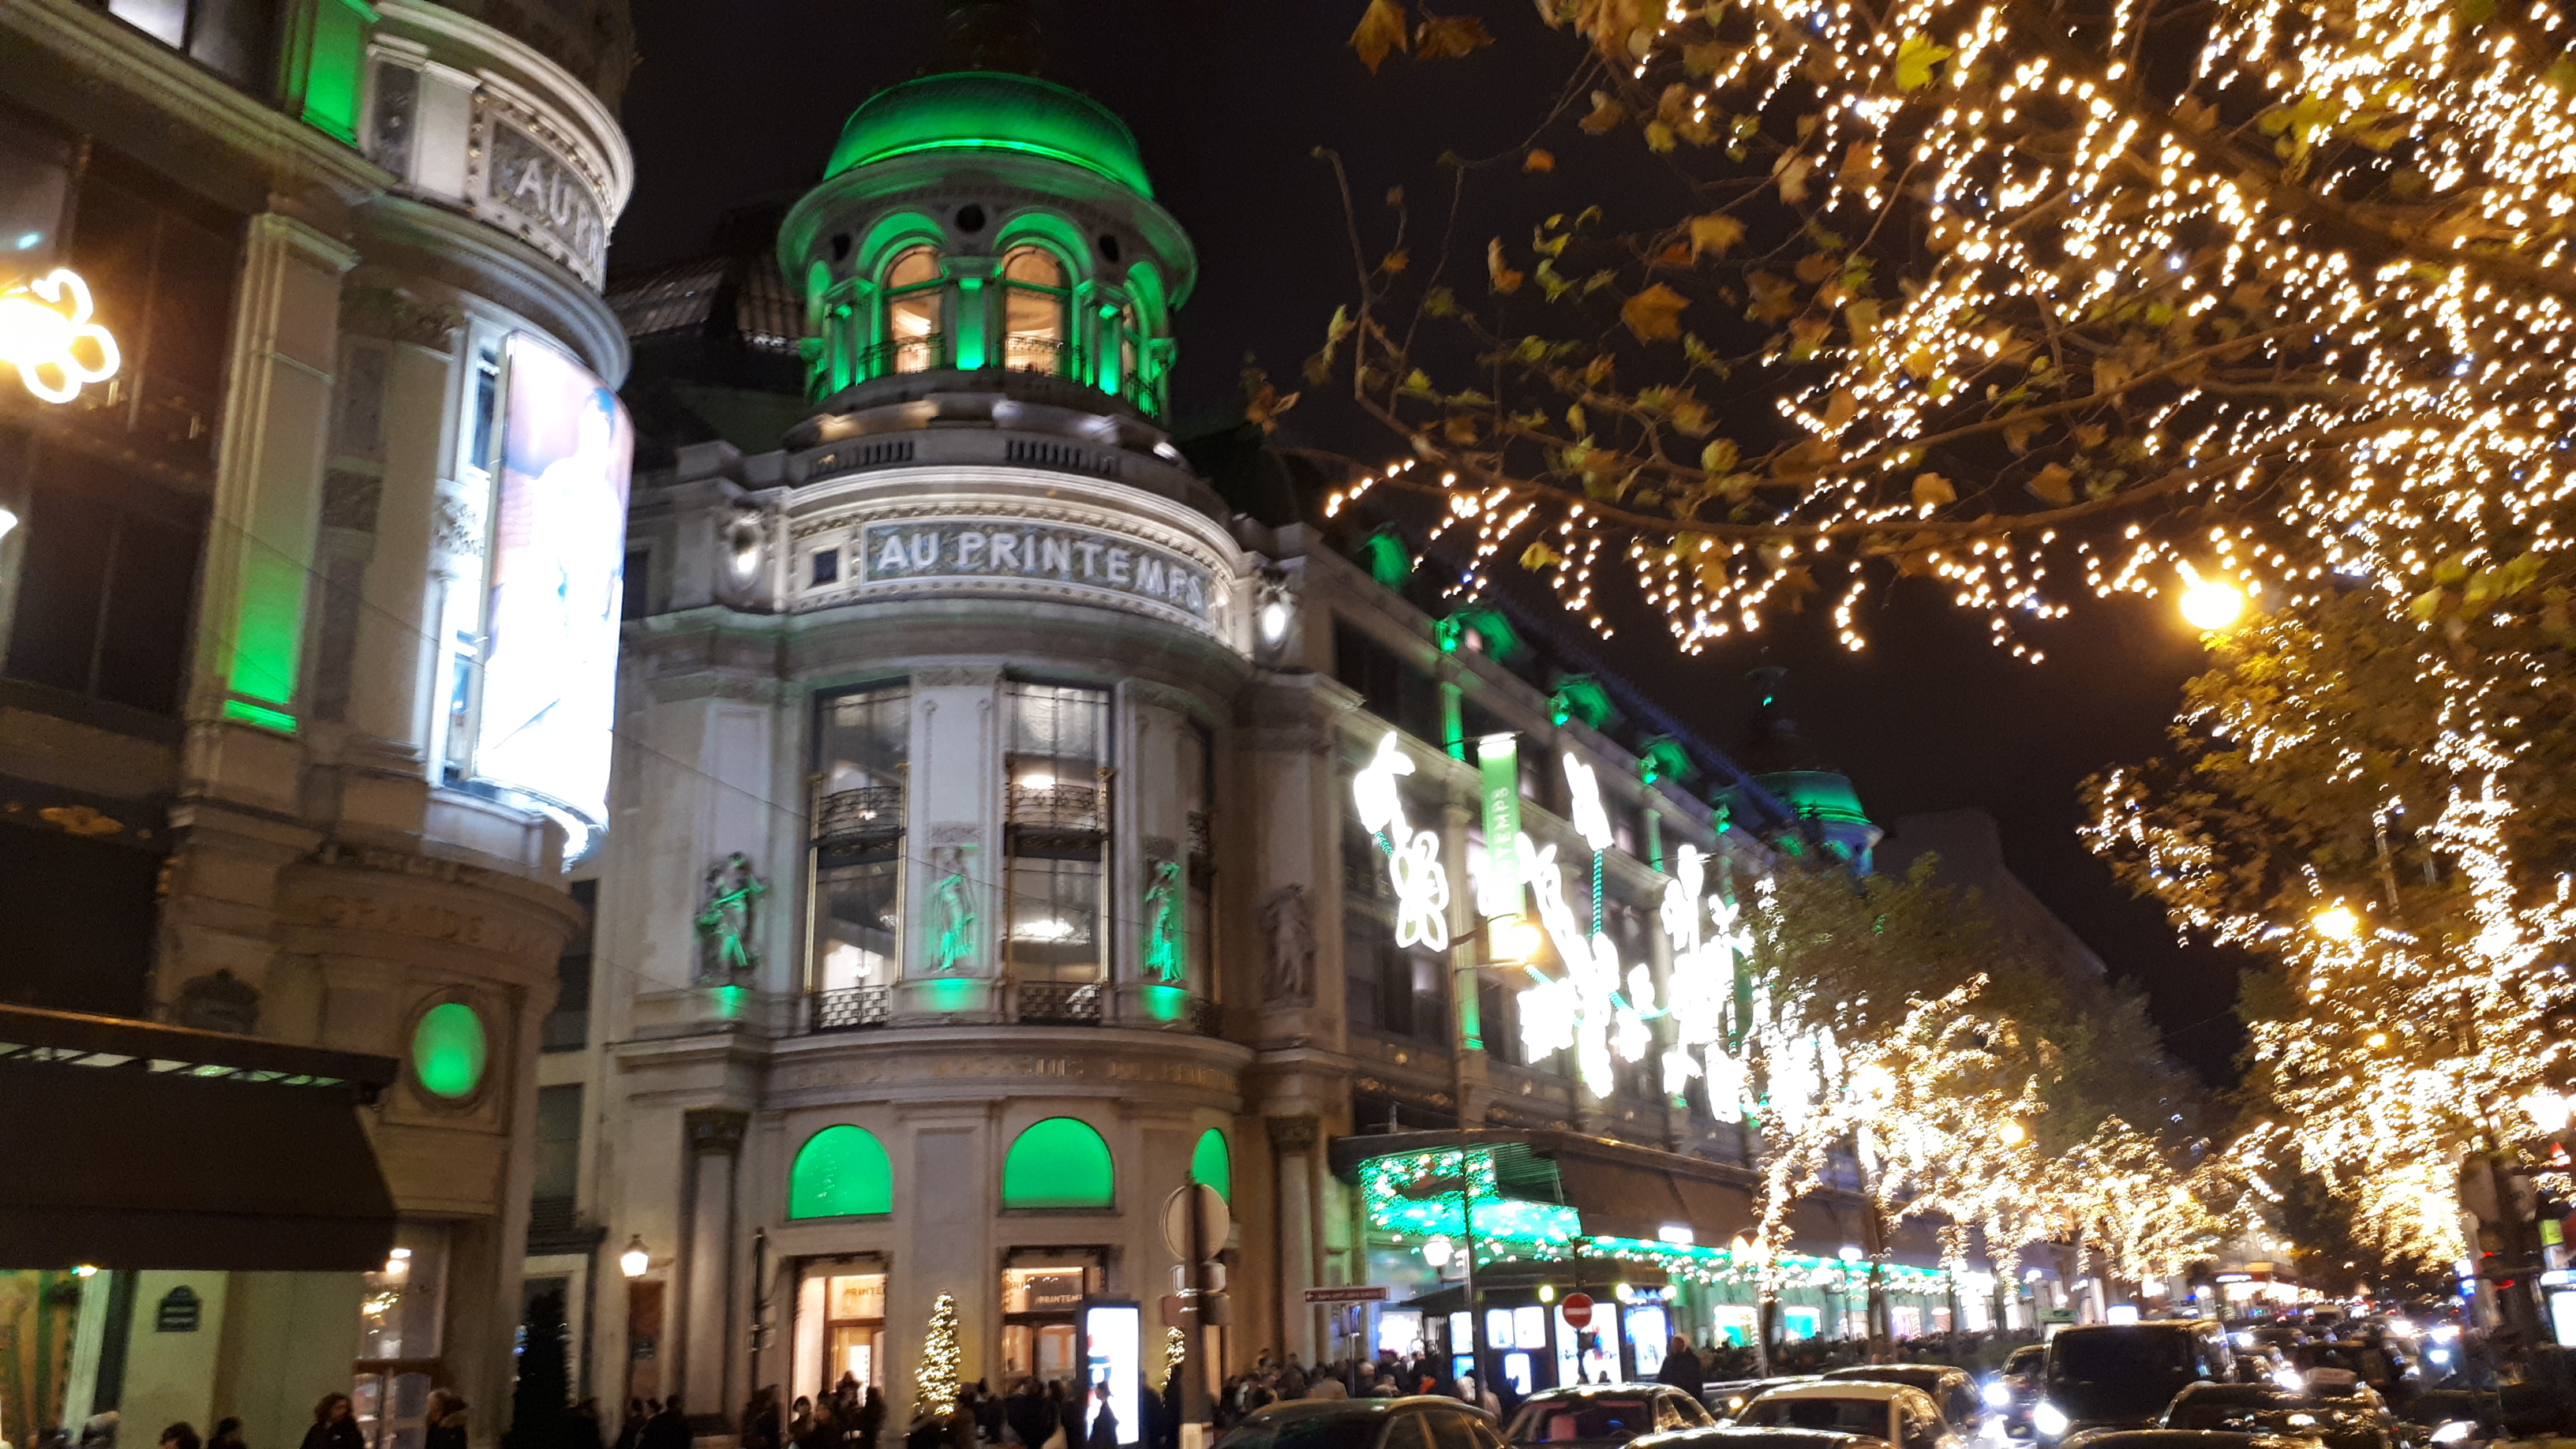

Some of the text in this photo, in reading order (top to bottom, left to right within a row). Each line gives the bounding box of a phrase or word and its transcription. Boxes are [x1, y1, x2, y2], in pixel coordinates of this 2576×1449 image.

[514, 159, 572, 227] AU
[877, 531, 1203, 610] AU PRINTEMPS
